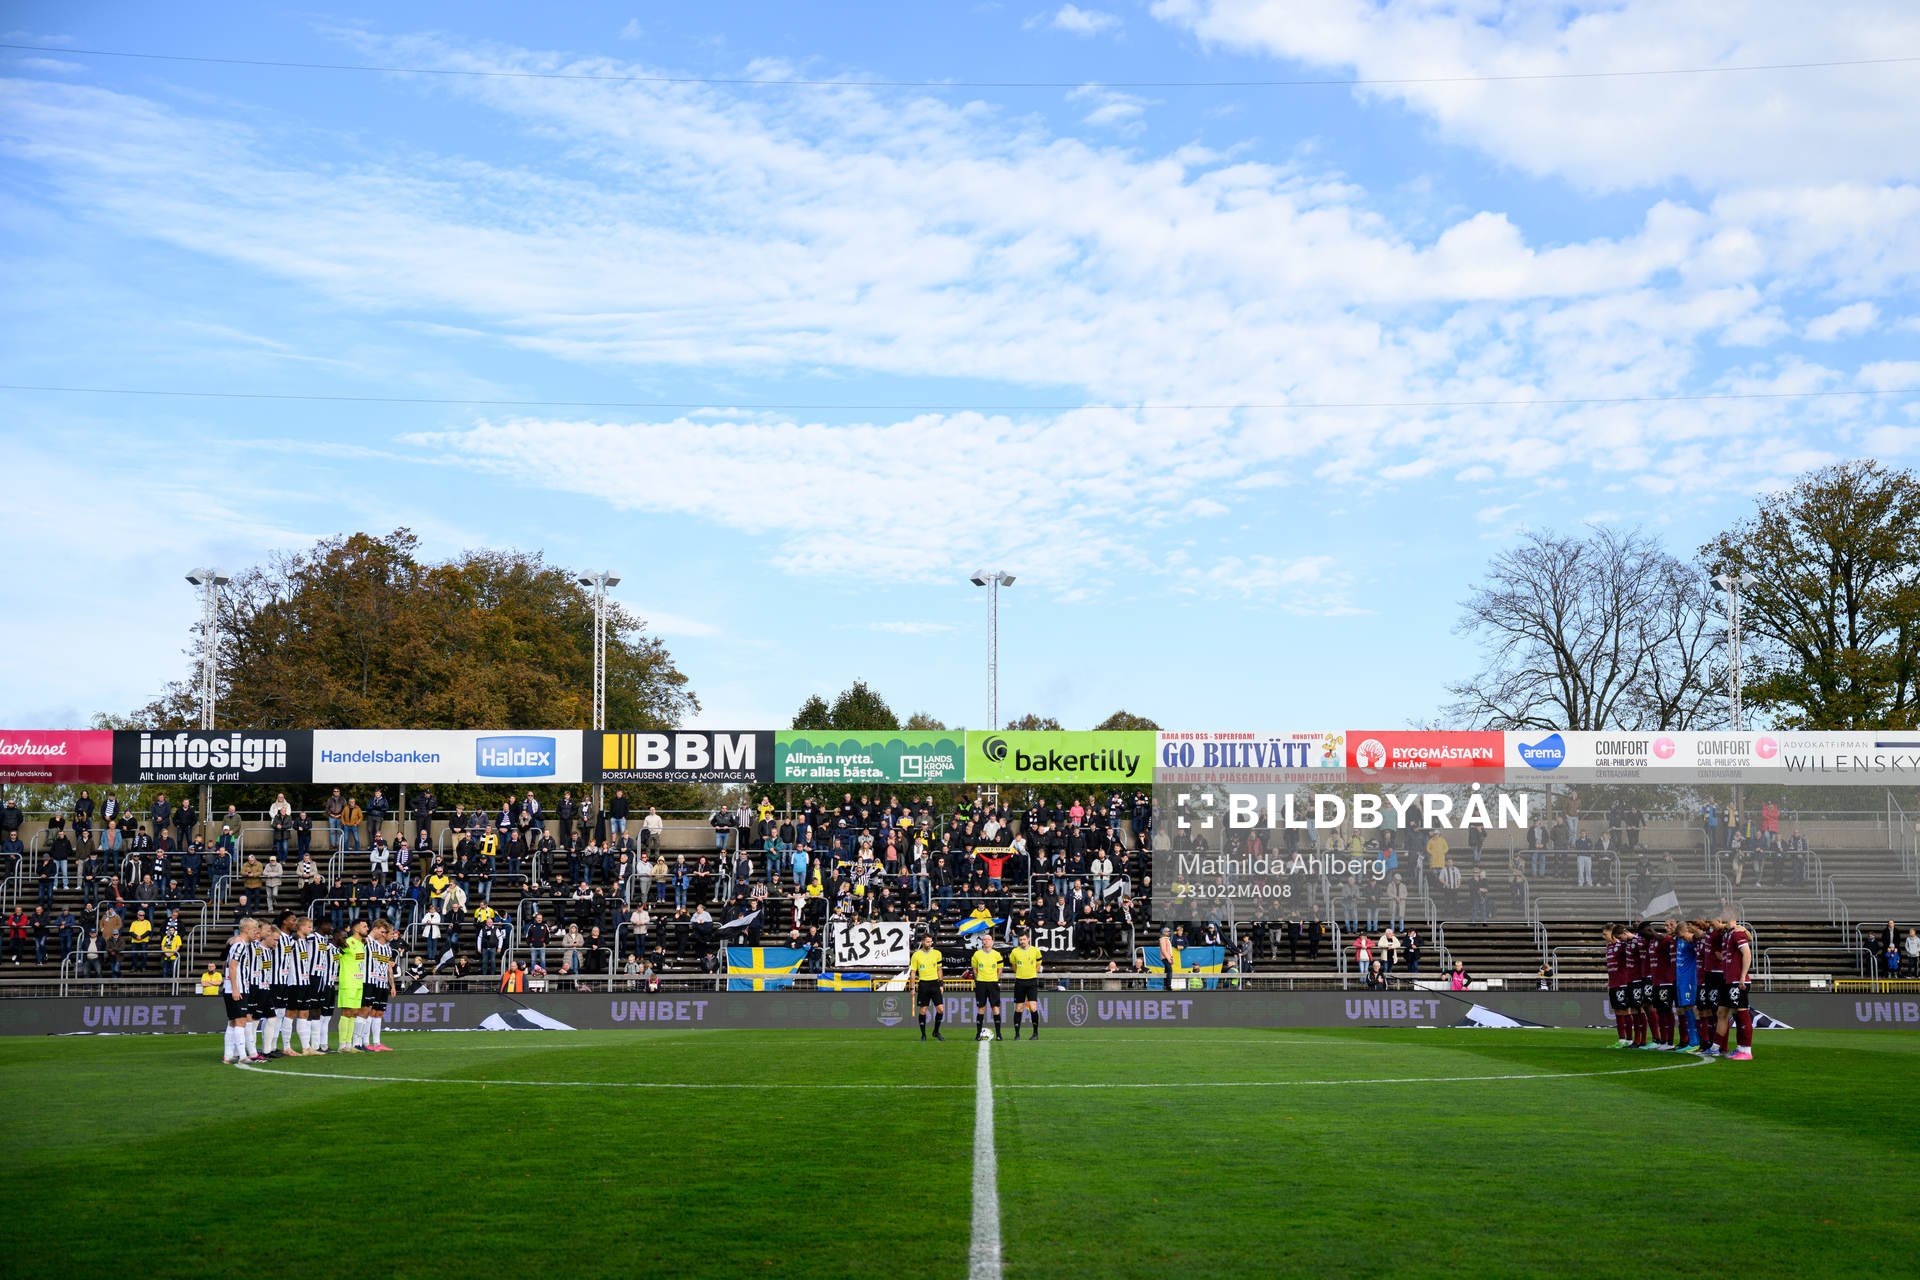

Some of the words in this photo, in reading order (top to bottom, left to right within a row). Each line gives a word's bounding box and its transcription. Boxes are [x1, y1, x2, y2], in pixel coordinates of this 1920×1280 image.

[140, 733, 286, 772] infosign
[636, 733, 756, 769] BBM
[1163, 742, 1195, 768] GO
[1203, 738, 1311, 768] BILTVÄTT
[1595, 740, 1649, 755] COMFORT
[1697, 740, 1752, 755] COMFORT
[321, 750, 440, 763] Handelsbanken
[482, 748, 550, 767] Haldex
[785, 752, 833, 764] Allmän
[836, 752, 874, 766] nytta.
[923, 755, 953, 763] LANDS
[1015, 748, 1140, 778] bakertilly
[1595, 758, 1635, 767] CARL-PHILIPS
[1635, 758, 1648, 767] VVS
[1738, 758, 1751, 767] VVS
[1784, 755, 1920, 773] WILENSKY
[785, 766, 807, 777] För
[810, 766, 841, 777] allas
[843, 766, 884, 777] bästa.
[923, 762, 955, 770] KRONA
[1397, 760, 1427, 769] SKÅNE
[140, 771, 154, 781] Allt
[156, 771, 177, 781] inom
[178, 771, 207, 783] skyltar
[208, 771, 215, 781] &
[217, 771, 240, 783] print!
[602, 771, 663, 780] BORSTAHUSENS
[665, 771, 689, 780] BYGG
[690, 771, 697, 780] &
[699, 771, 742, 780] MONTAGE
[744, 771, 756, 780] AB
[923, 770, 943, 778] HEM
[1162, 772, 1175, 783] NU
[1205, 770, 1217, 783] PÅ
[1284, 772, 1345, 783] PUMPGATAN!
[840, 926, 904, 959] 1312
[1035, 926, 1076, 952] 261
[874, 949, 889, 959] 261
[83, 1004, 186, 1026] UNIBET
[383, 1002, 456, 1023] NIBET
[610, 1000, 709, 1021] UNIBET
[1097, 1000, 1193, 1020] UNIBET
[1345, 999, 1441, 1020] UNIBET
